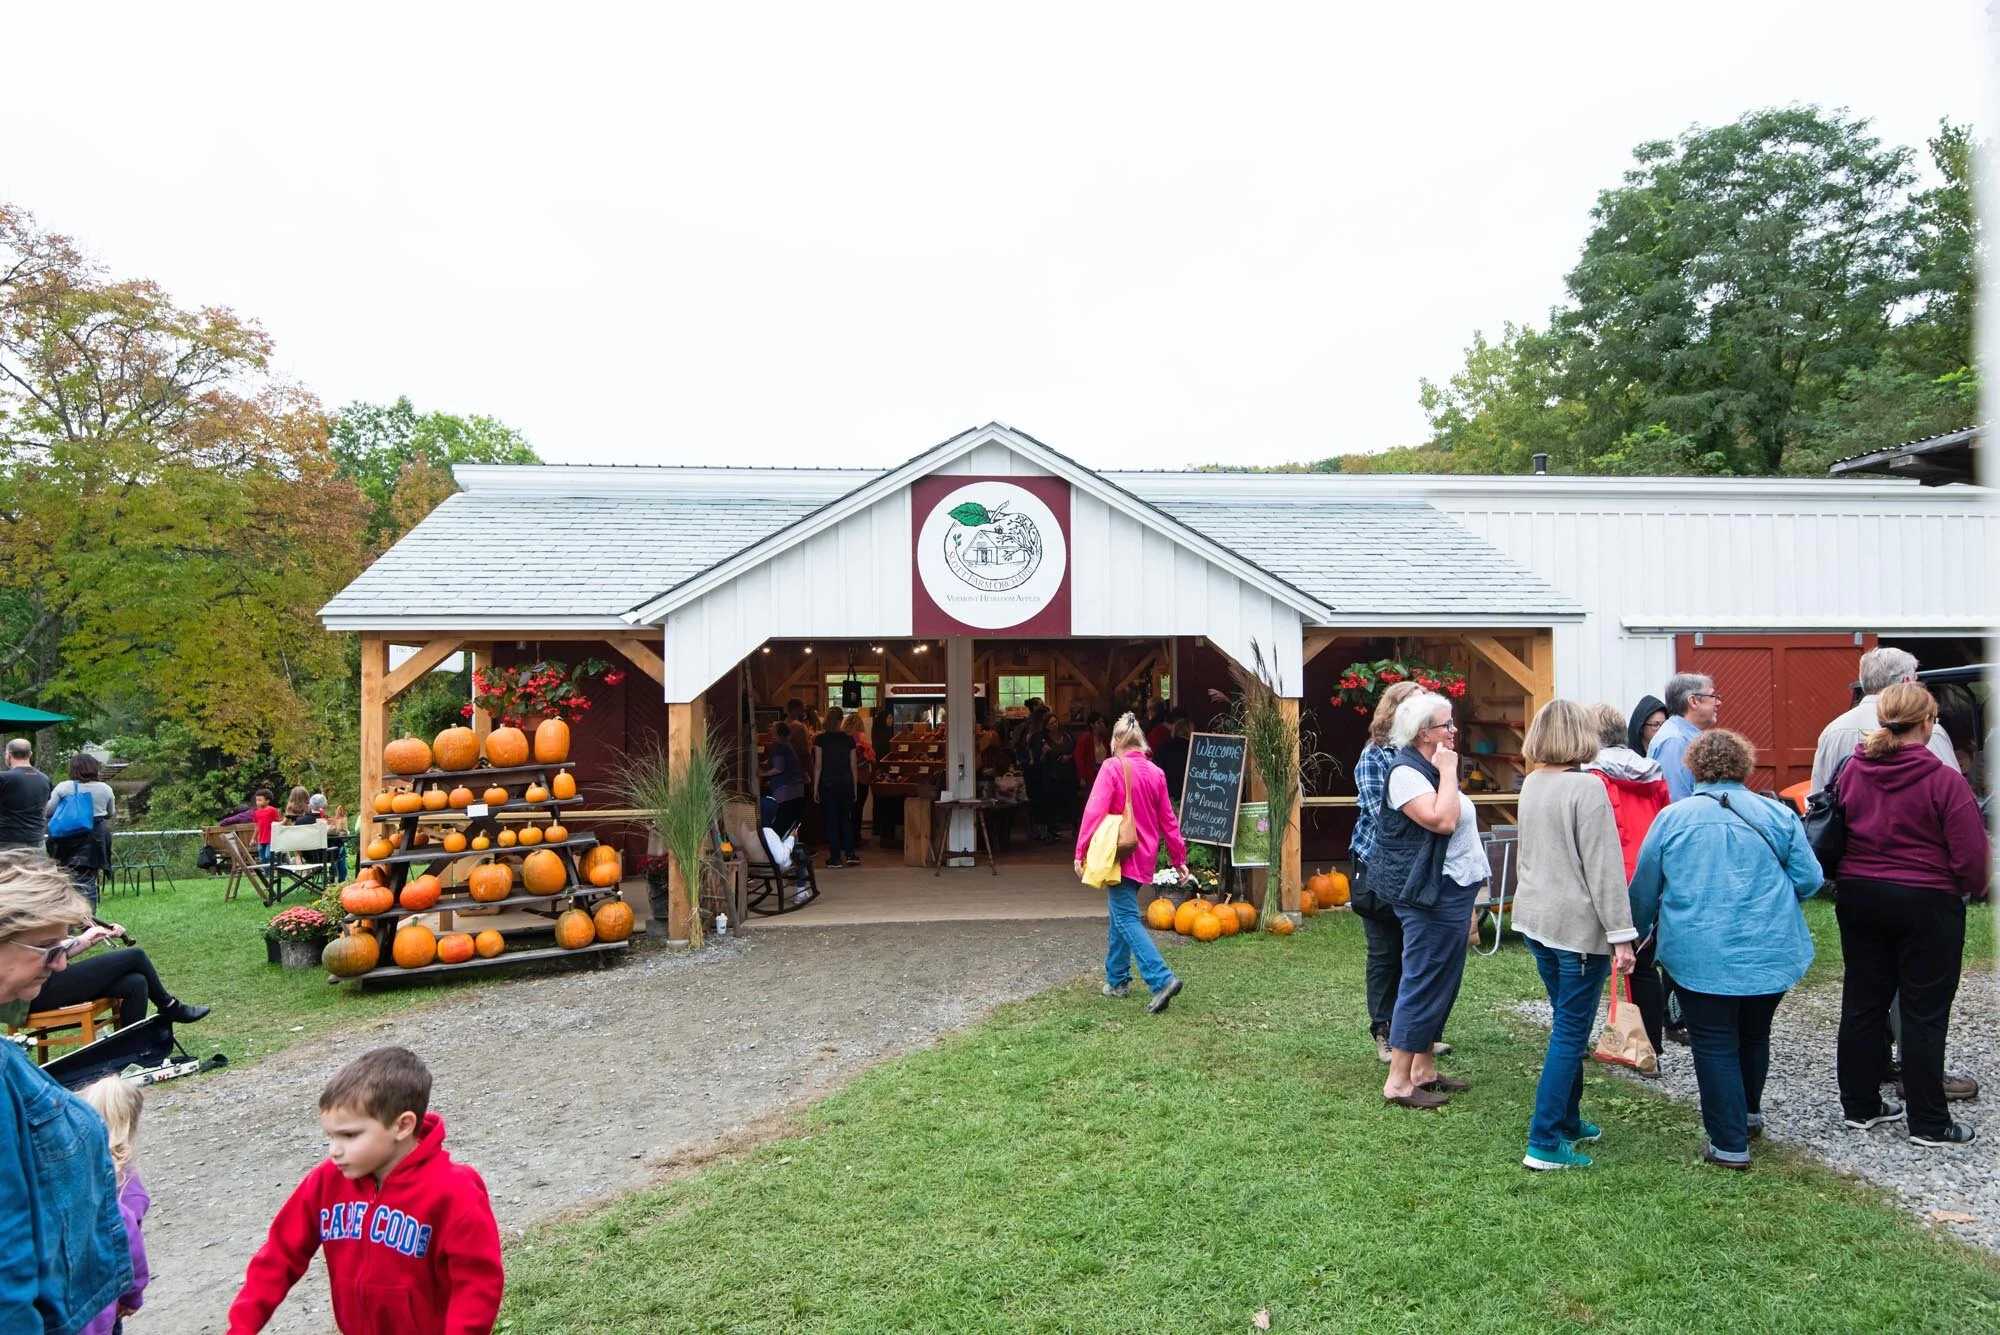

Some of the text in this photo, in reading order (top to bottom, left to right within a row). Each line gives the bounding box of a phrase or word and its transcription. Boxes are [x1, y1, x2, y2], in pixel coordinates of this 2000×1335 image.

[968, 574, 992, 589] FARM
[993, 567, 1034, 589] ORCHARD
[1196, 738, 1243, 759] WELCOME
[1209, 759, 1218, 768] to
[370, 1205, 420, 1256] COD
